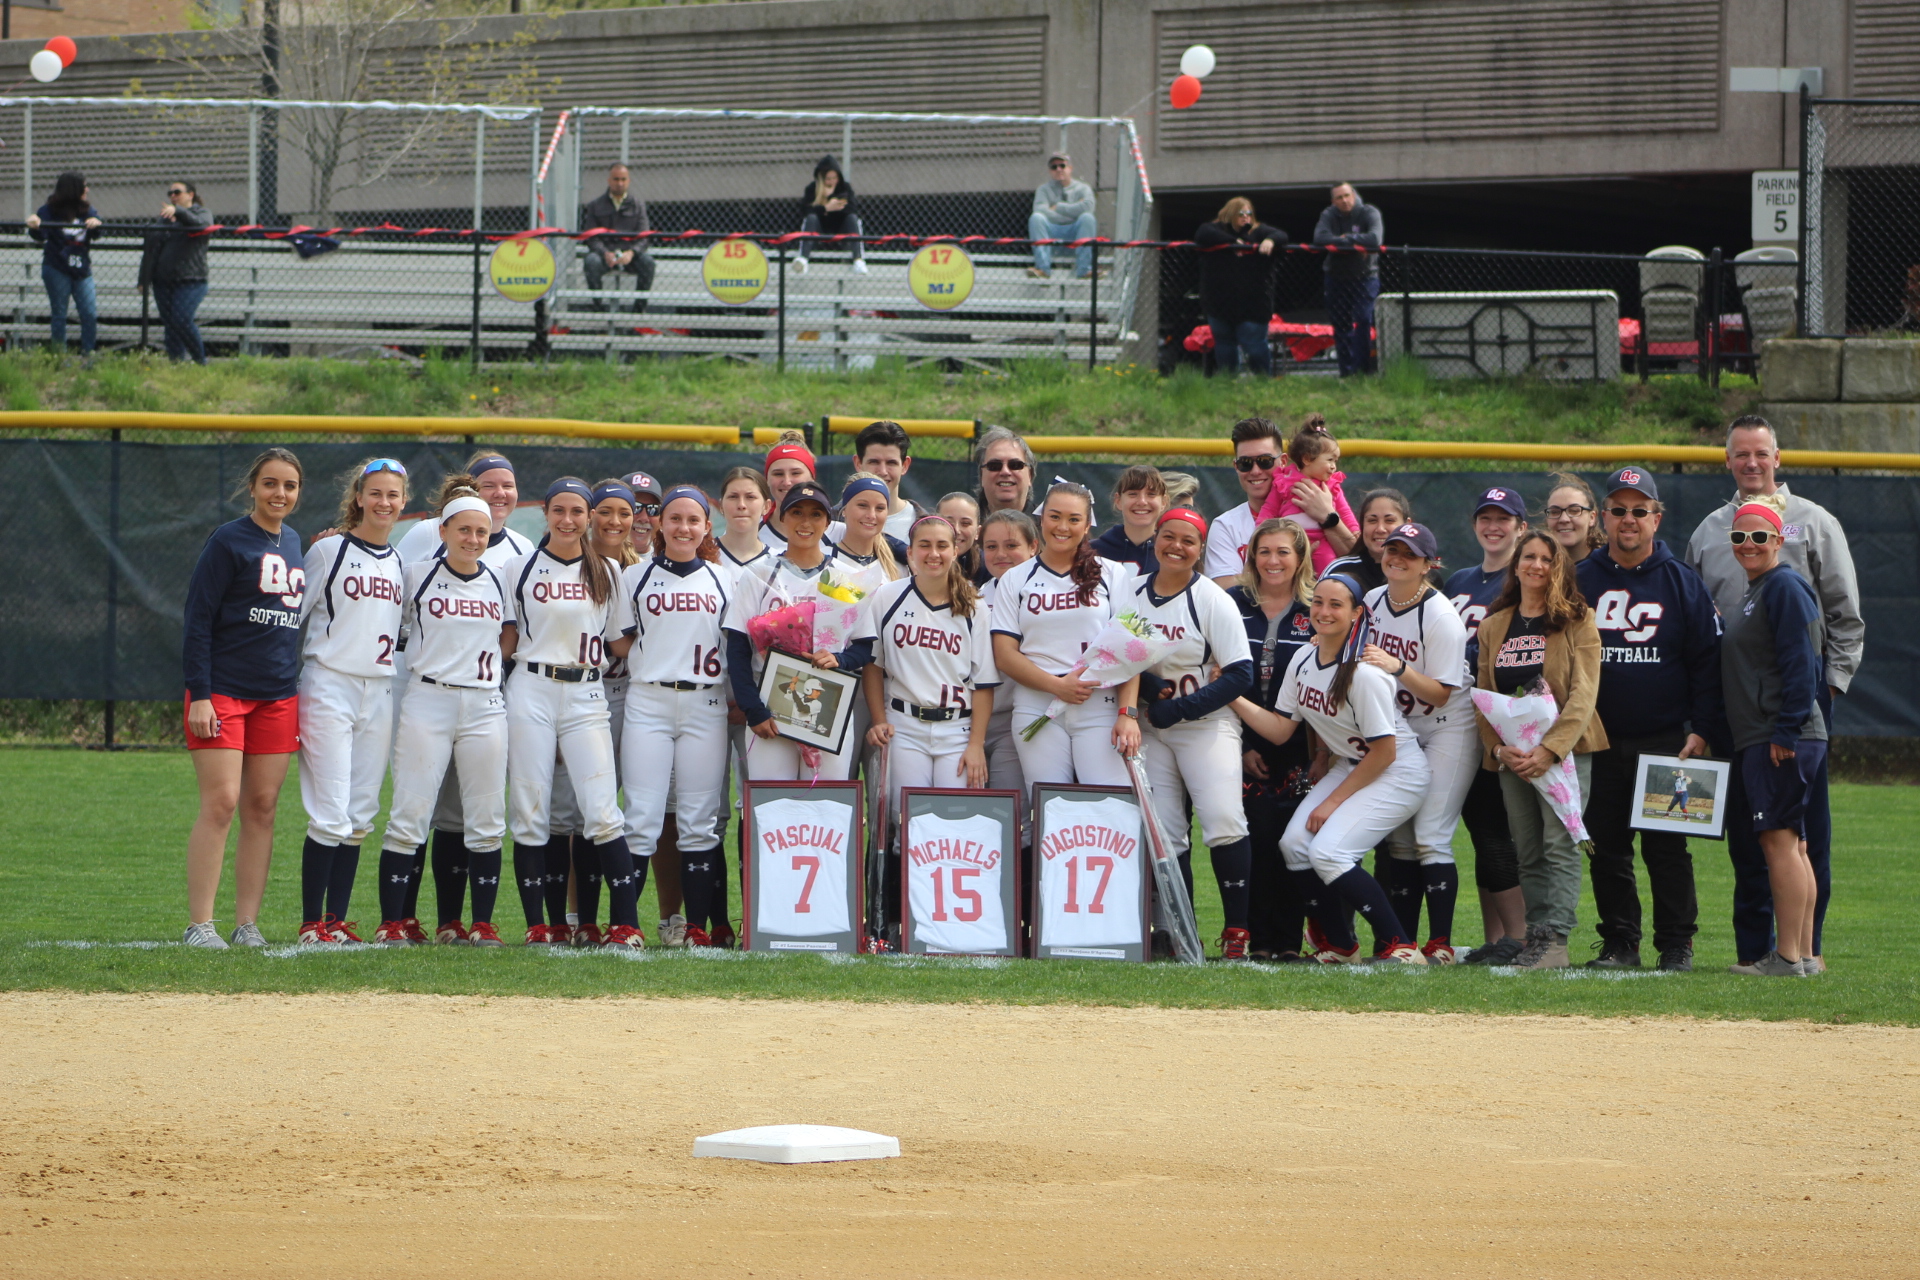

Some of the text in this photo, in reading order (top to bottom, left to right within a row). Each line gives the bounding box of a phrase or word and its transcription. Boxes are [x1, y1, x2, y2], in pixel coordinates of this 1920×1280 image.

[1757, 178, 1799, 190] PARKIN
[1766, 193, 1795, 206] FIELD
[1774, 210, 1787, 233] 5
[515, 240, 529, 256] 7
[723, 243, 747, 258] 15
[930, 249, 952, 264] 17
[498, 277, 548, 285] LAUREN
[711, 279, 760, 287] SHIKKI
[928, 283, 955, 294] MJ
[343, 575, 402, 606] QUEENS
[532, 582, 604, 604] QUEEN
[428, 597, 501, 621] QUEENS
[646, 592, 717, 617] QUEENS
[1595, 588, 1664, 642] QC
[579, 632, 602, 667] 10
[893, 623, 962, 656] QUEENS
[477, 650, 493, 682] 11
[693, 644, 722, 678] 16
[939, 684, 967, 710] 15
[762, 824, 844, 855] PASCUAL
[1040, 824, 1136, 861] D'AGOSTINO
[909, 838, 1000, 870] MICHAELS
[792, 855, 820, 913] 7
[930, 866, 983, 922] 15
[1064, 855, 1114, 914] 17
